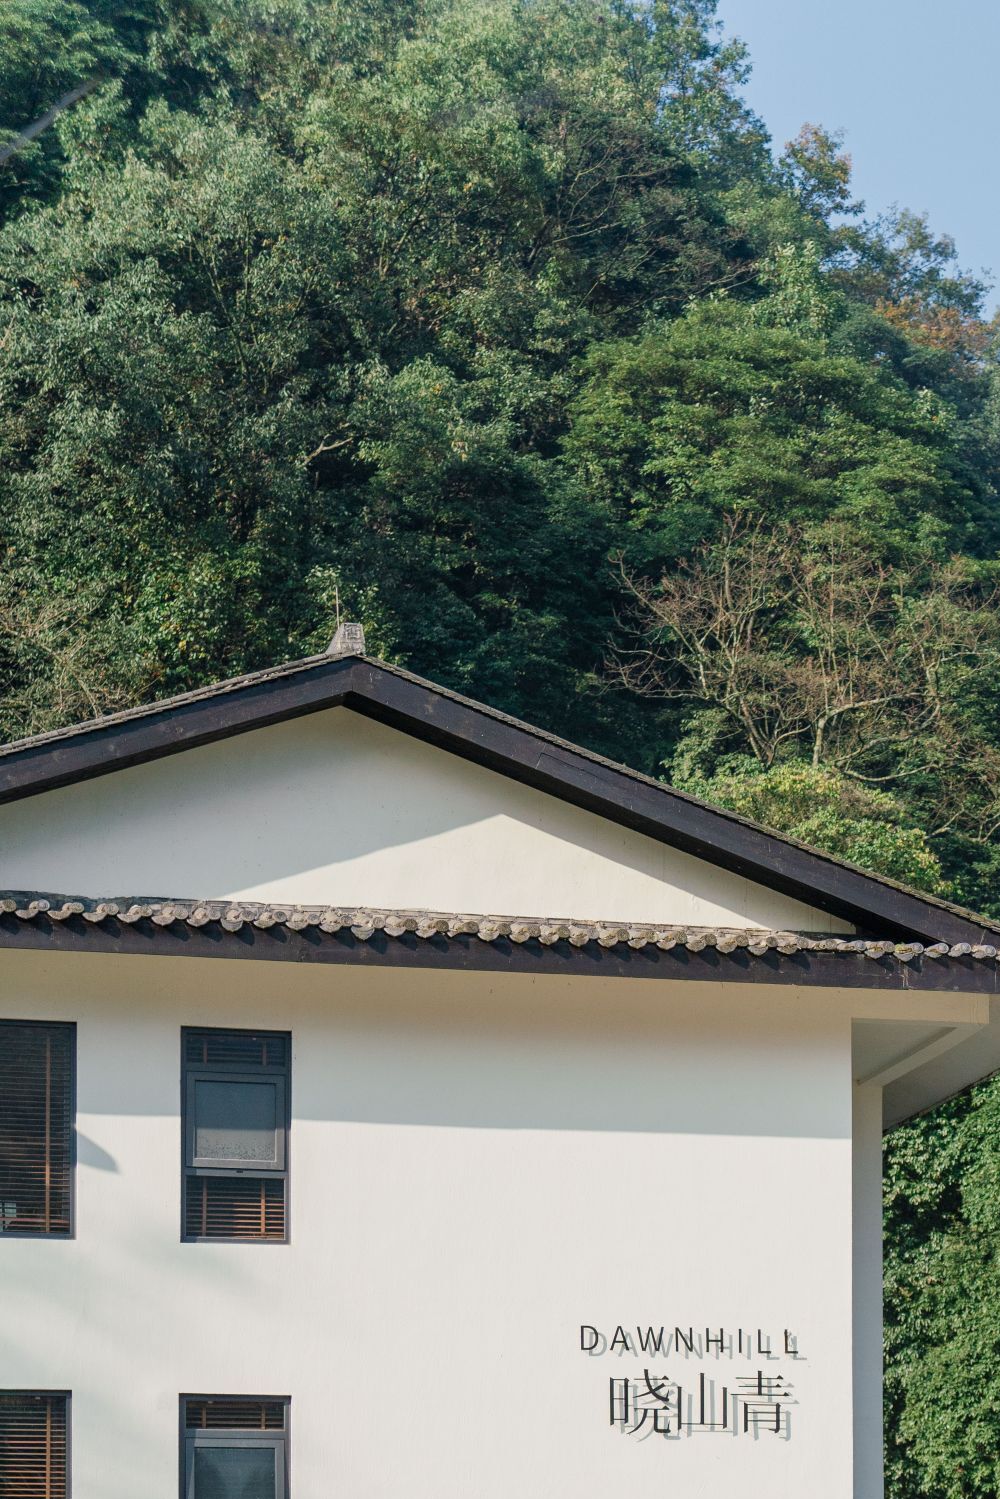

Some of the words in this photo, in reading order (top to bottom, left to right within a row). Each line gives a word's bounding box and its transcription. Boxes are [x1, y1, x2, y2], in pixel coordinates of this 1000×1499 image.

[579, 1325, 799, 1355] DAWNHILL
[609, 1368, 791, 1435] 晓山青
